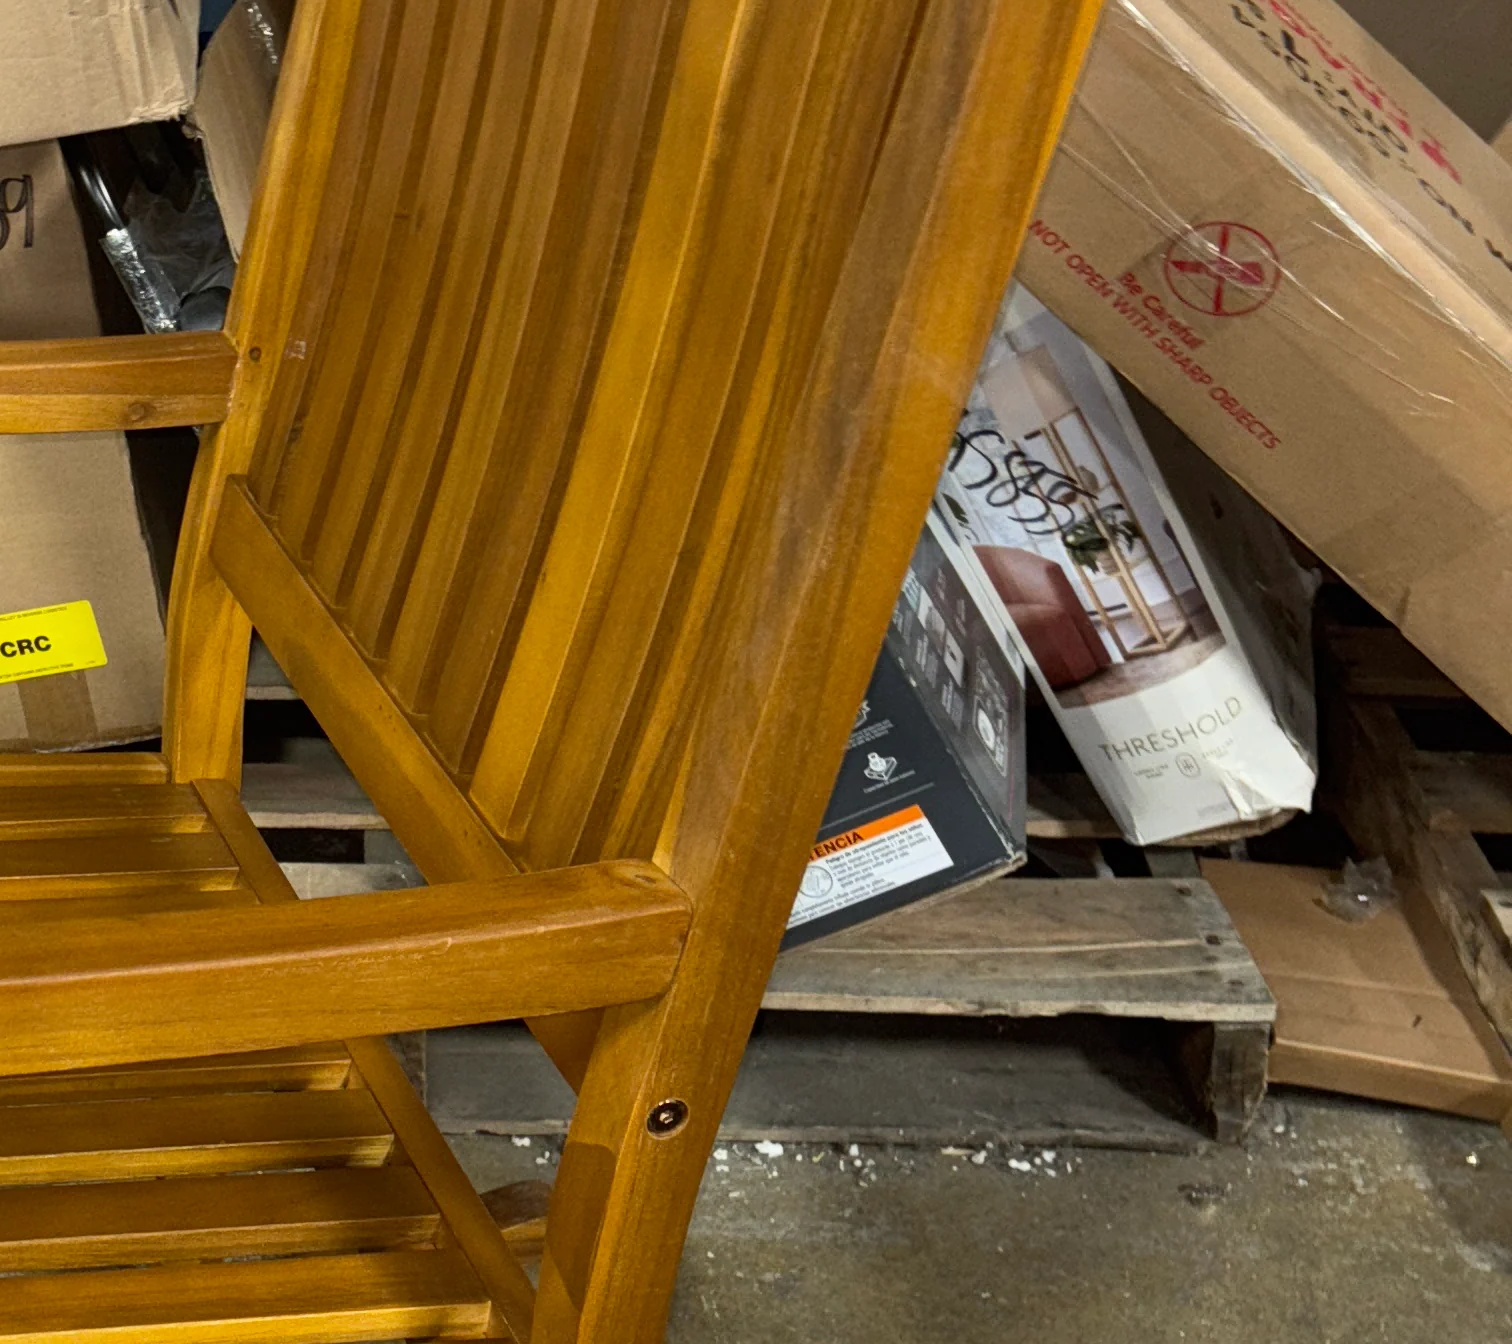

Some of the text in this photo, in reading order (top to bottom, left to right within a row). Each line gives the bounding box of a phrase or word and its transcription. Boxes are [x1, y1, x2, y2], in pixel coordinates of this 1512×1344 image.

[1027, 217, 1283, 453] NOT OPEN WITH SHARP OBJECTS
[1139, 290, 1205, 352] Careful
[0, 635, 52, 658] CRC
[1098, 695, 1243, 764] THRESHOLD
